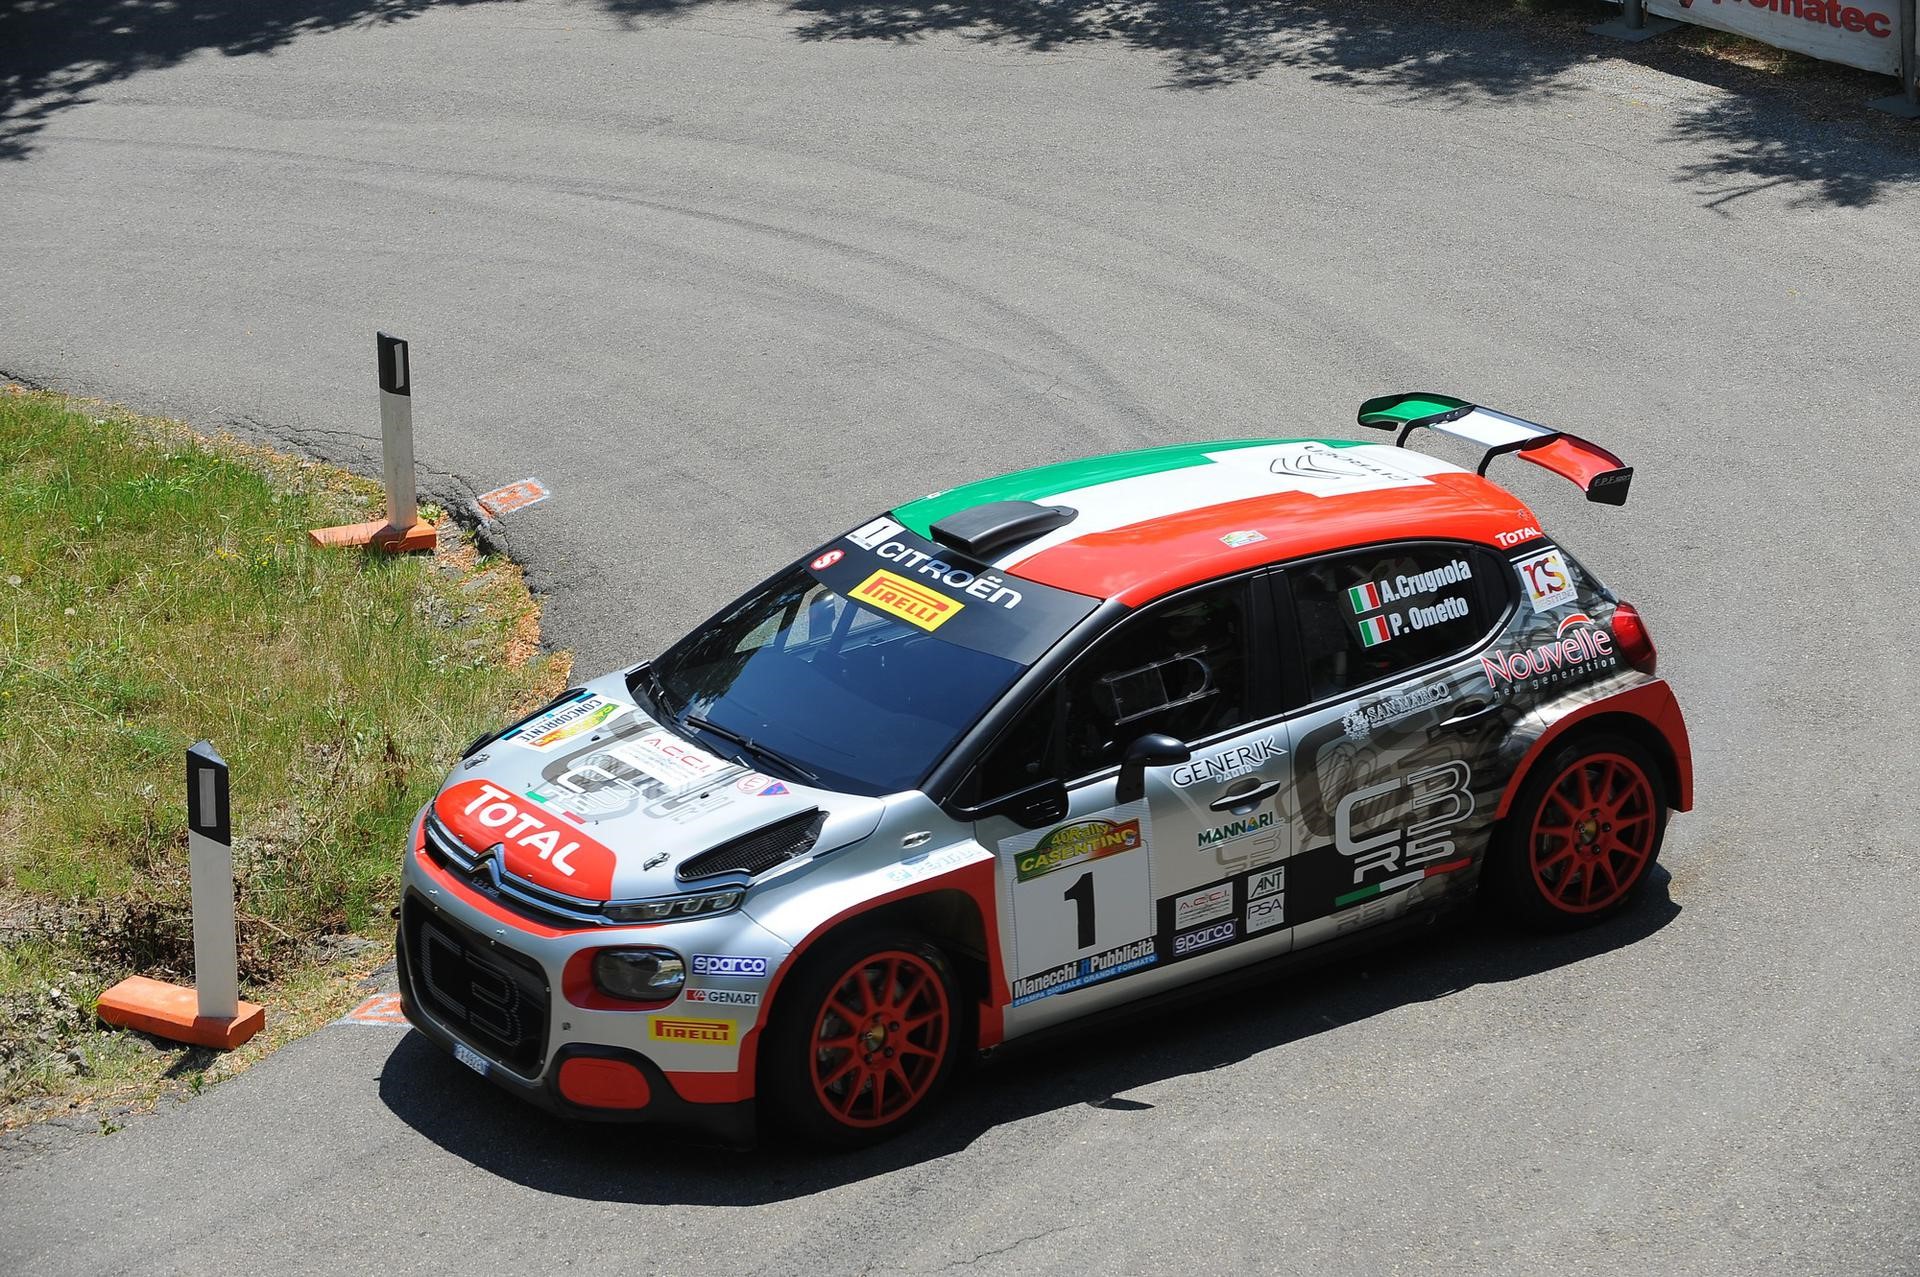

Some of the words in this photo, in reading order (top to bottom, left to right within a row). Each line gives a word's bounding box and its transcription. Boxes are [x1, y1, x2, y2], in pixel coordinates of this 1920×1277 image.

[864, 525, 891, 540] 1
[1494, 525, 1542, 547] TOTAL
[813, 550, 842, 569] S
[861, 576, 949, 622] PIRELLI
[1380, 559, 1473, 603] A.Crugnola
[1409, 596, 1470, 631] Ometto
[1480, 627, 1614, 689] Nouvelle
[1492, 684, 1521, 699] new
[1532, 656, 1617, 690] generation
[1171, 738, 1286, 787] GENERIK
[1335, 758, 1476, 857] C3
[463, 784, 582, 876] TOTAL
[1198, 811, 1274, 847] MANNARI
[1021, 828, 1137, 872] CASENTINO
[1250, 872, 1283, 898] ANT
[1064, 871, 1096, 950] 1
[1248, 898, 1283, 920] PSA
[1090, 937, 1155, 973] Pubblicità
[1175, 923, 1235, 951] sparco
[694, 957, 766, 975] sparco
[1014, 991, 1047, 1006] STAMPA
[1047, 979, 1082, 996] DIGITALE
[1083, 968, 1117, 984] GRANDE
[1117, 956, 1156, 974] FORMATO
[708, 990, 758, 1005] GENART
[655, 1020, 729, 1041] PIRELLI
